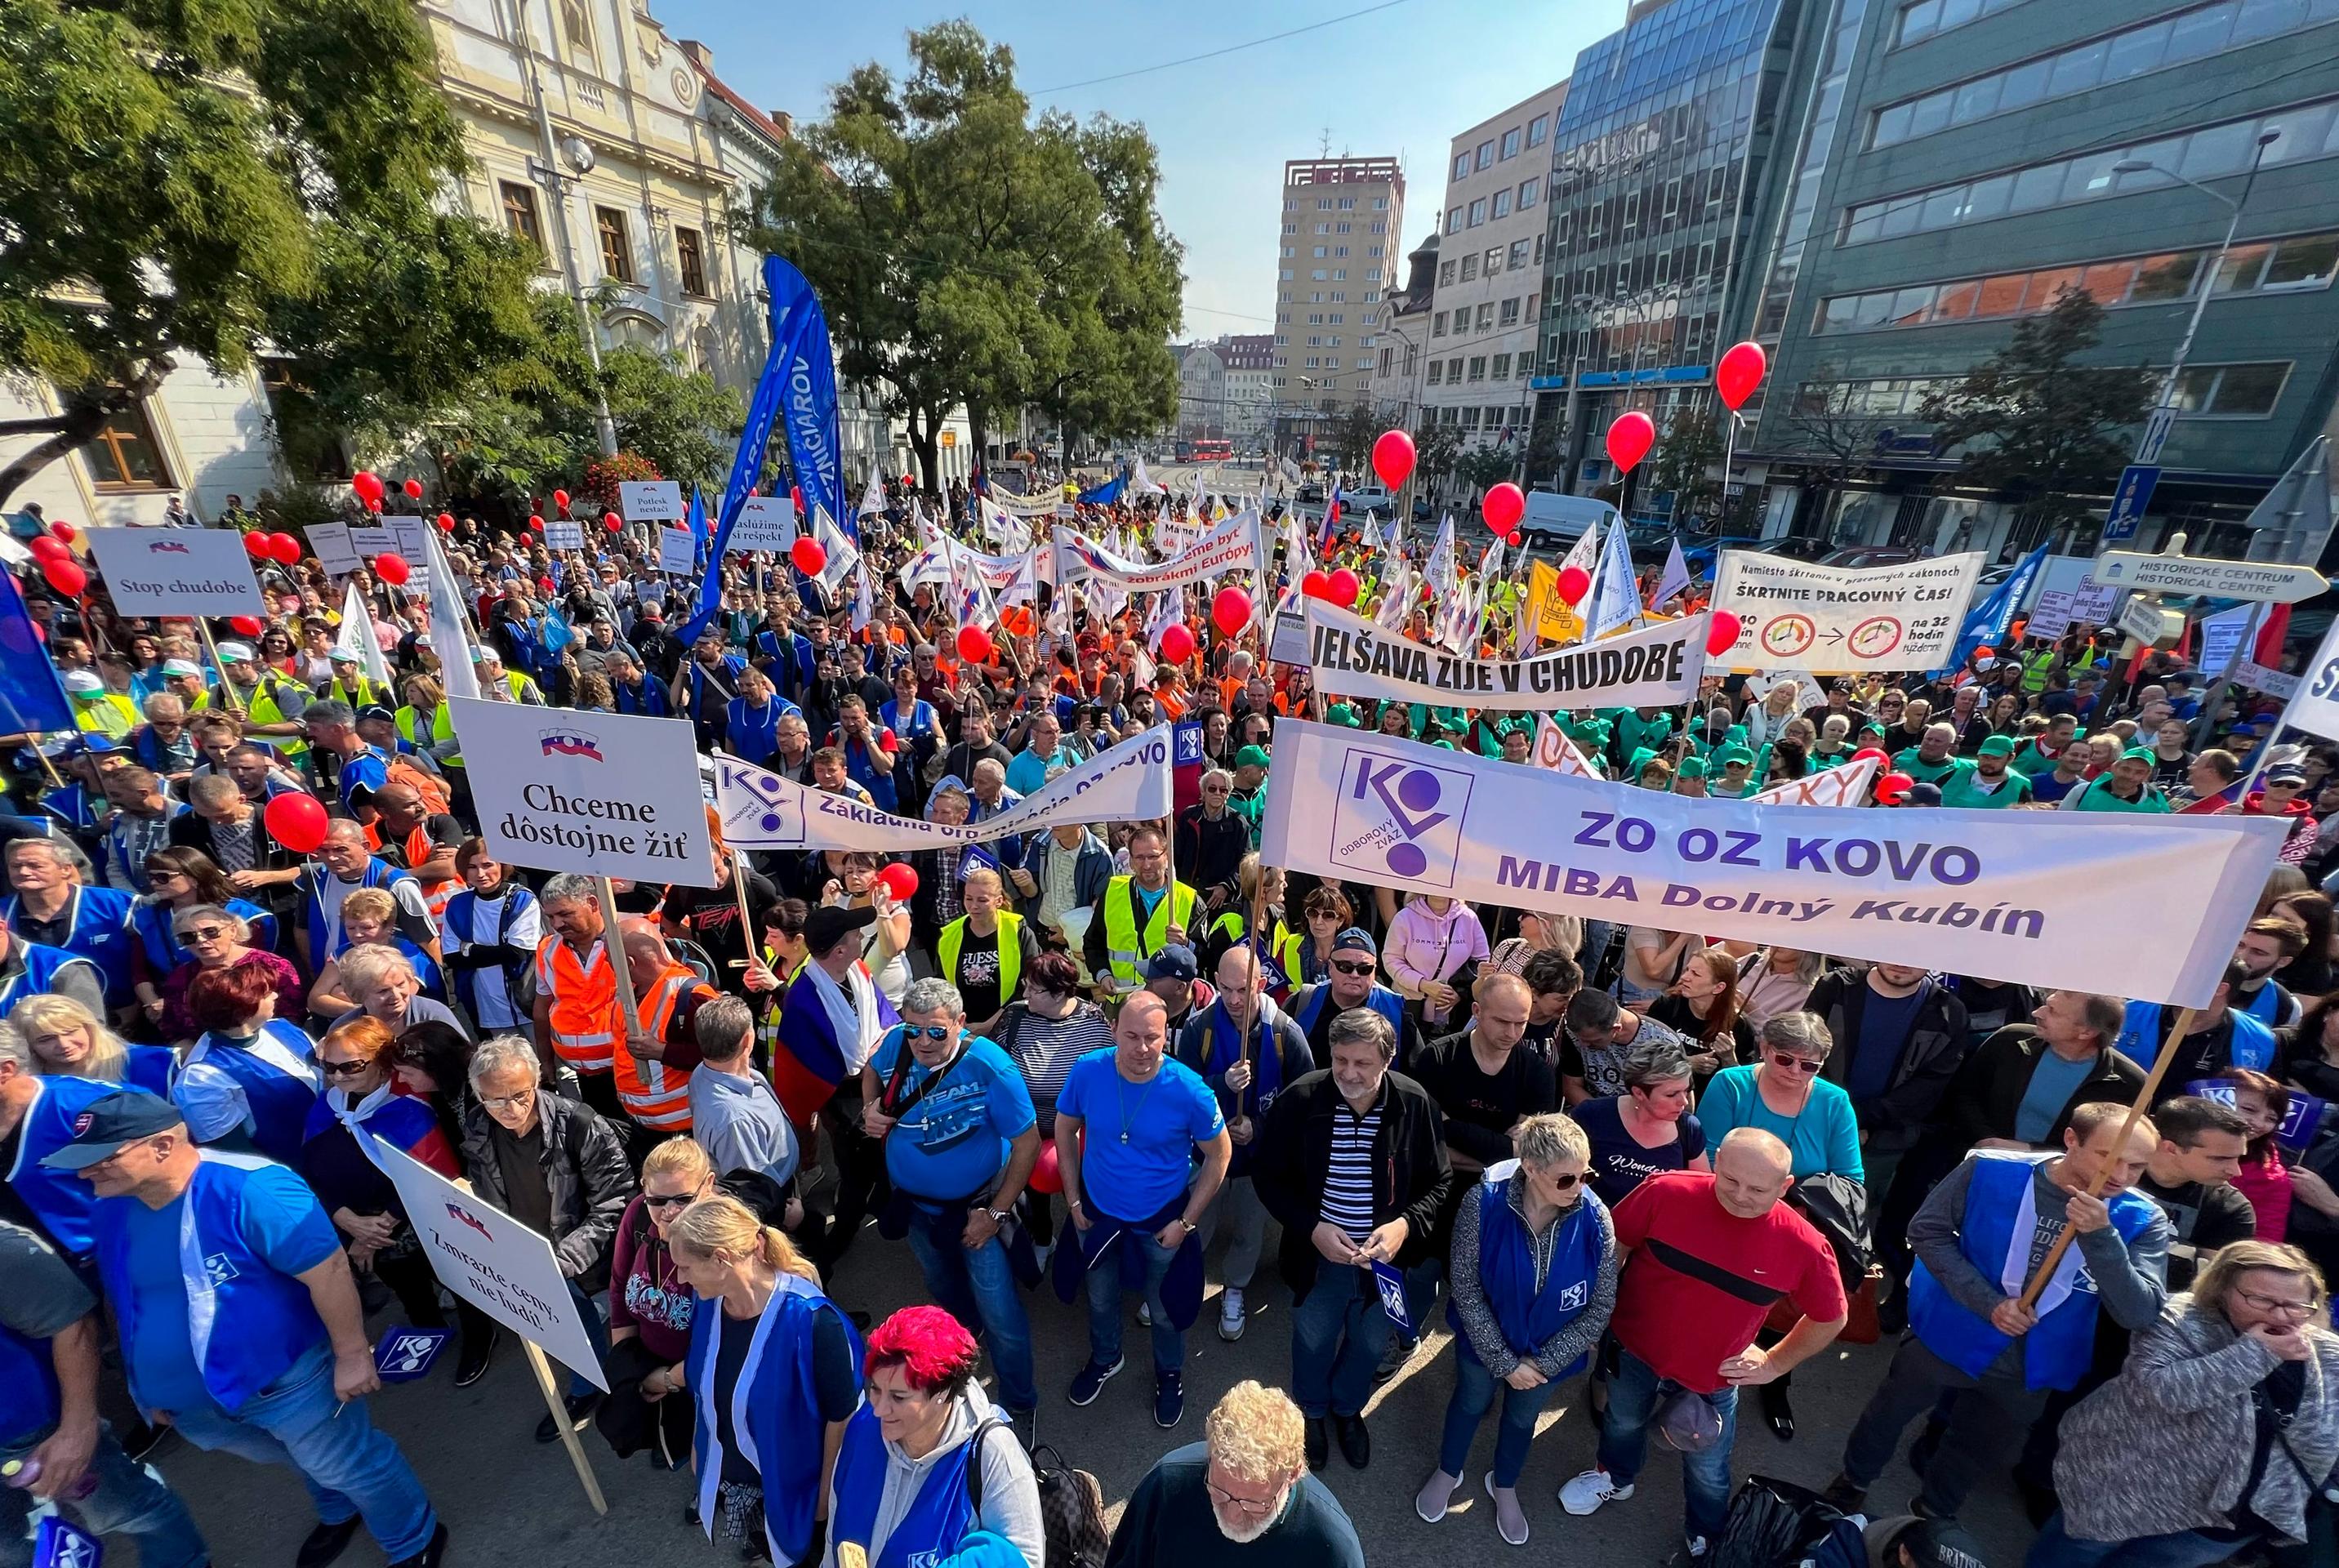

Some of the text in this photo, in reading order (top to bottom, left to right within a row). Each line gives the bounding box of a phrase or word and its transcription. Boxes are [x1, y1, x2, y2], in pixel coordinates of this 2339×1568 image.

[638, 497, 668, 506] Potlesk
[733, 519, 785, 531] aslúžime
[1218, 525, 1241, 546] byť
[732, 531, 782, 543] si rešpekt
[1126, 564, 1198, 584] žobrákmi
[1201, 541, 1254, 569] Európy!
[1741, 564, 1785, 577] Namiesto
[1908, 566, 1960, 579] zákonoch
[2139, 562, 2295, 584] HISTORICKÉ CENTRUM
[120, 579, 247, 597] Stop chudobe
[1736, 581, 1953, 603] ŠKRTNITE PRACOVNÝ ČAS!
[2135, 573, 2276, 595] HISTORICAL CENTRE
[1912, 616, 1950, 628] na 32
[1908, 628, 1945, 641] hodín
[1312, 626, 1429, 685] JELŠAVA
[1503, 664, 1521, 693] V
[1530, 639, 1686, 693] CHUDOBE
[523, 784, 656, 823] Chceme
[500, 813, 688, 860] dôstojne žiť
[1340, 817, 1393, 857] ODBOROVÝ
[1374, 828, 1402, 850] ZVÄZ
[1574, 810, 1980, 885] ZO OZ KOVO
[1496, 855, 2045, 939] MIBA Dolný Kubín
[429, 1227, 560, 1324] Zmrazte ceny,
[467, 1276, 497, 1301] nie
